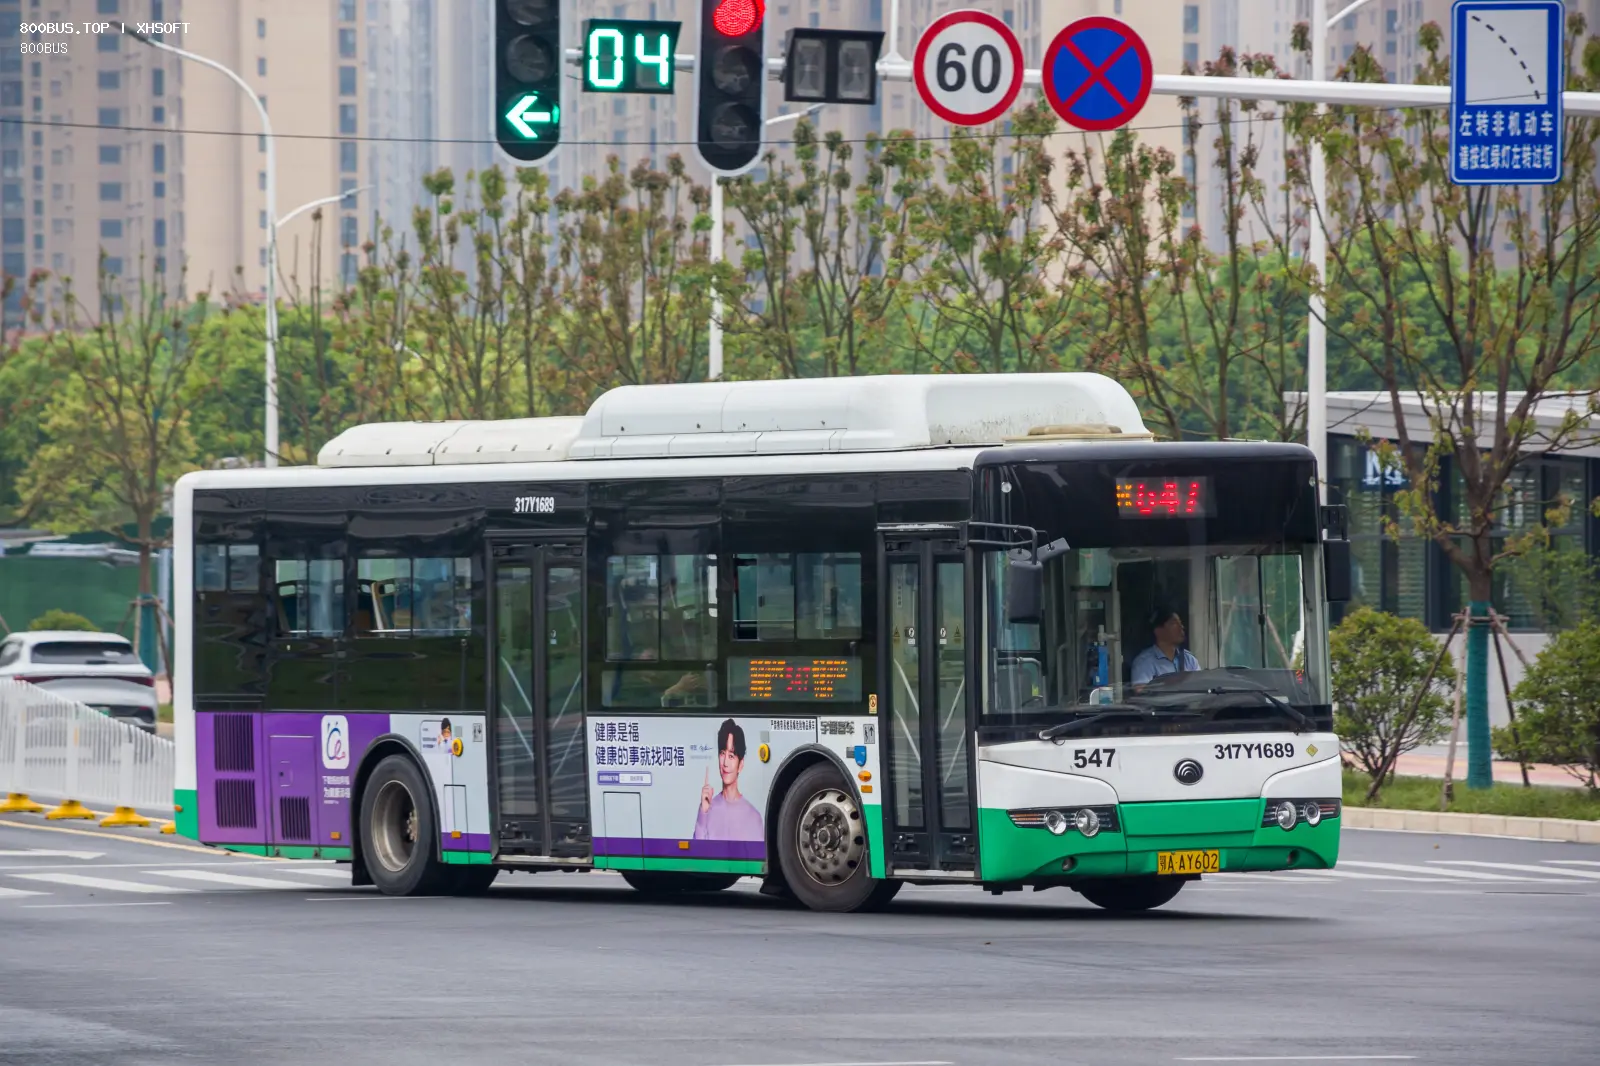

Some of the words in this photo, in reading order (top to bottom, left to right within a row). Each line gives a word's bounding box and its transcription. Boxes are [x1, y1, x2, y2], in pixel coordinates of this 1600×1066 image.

[588, 28, 670, 88] 04
[936, 43, 1002, 93] 60
[1459, 110, 1554, 137] 左转非机动车
[514, 496, 555, 513] 317Y1689
[594, 721, 640, 742] 健康是福
[595, 746, 685, 766] 健康的事就找阿福
[1074, 749, 1116, 768] 547
[1214, 743, 1295, 760] 317Y1689
